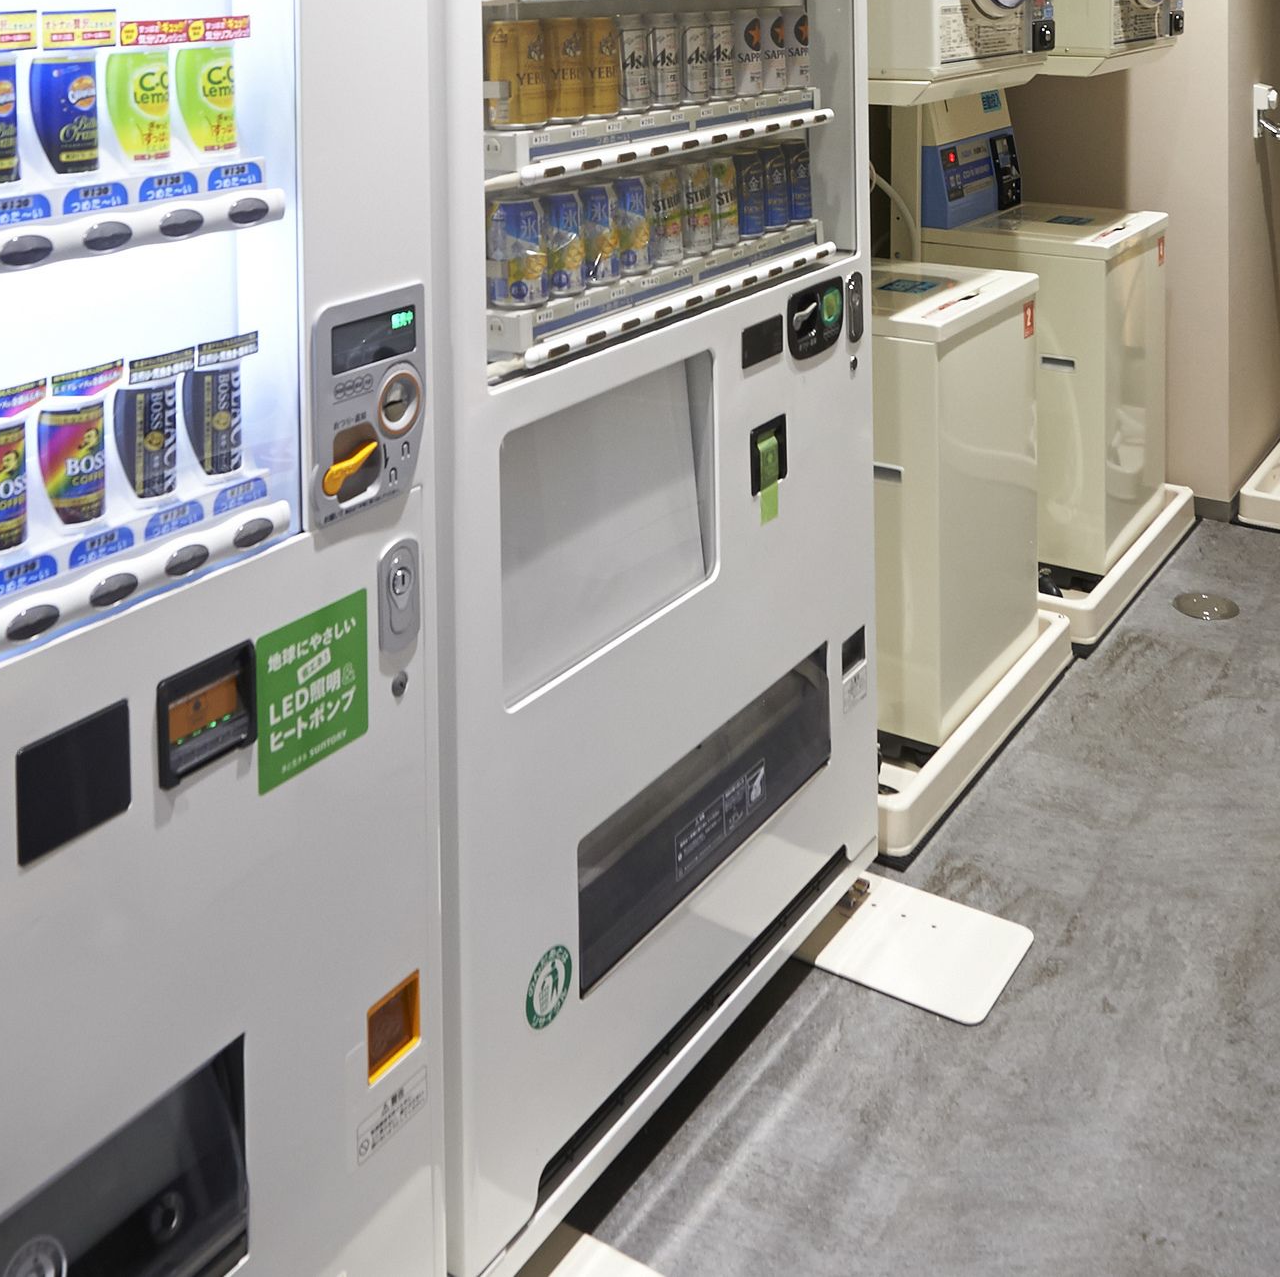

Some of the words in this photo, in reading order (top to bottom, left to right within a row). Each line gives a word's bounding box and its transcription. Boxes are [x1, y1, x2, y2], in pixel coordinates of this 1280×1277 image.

[267, 616, 357, 674] 地球にやさしい
[270, 687, 356, 753] ヒートポンプ
